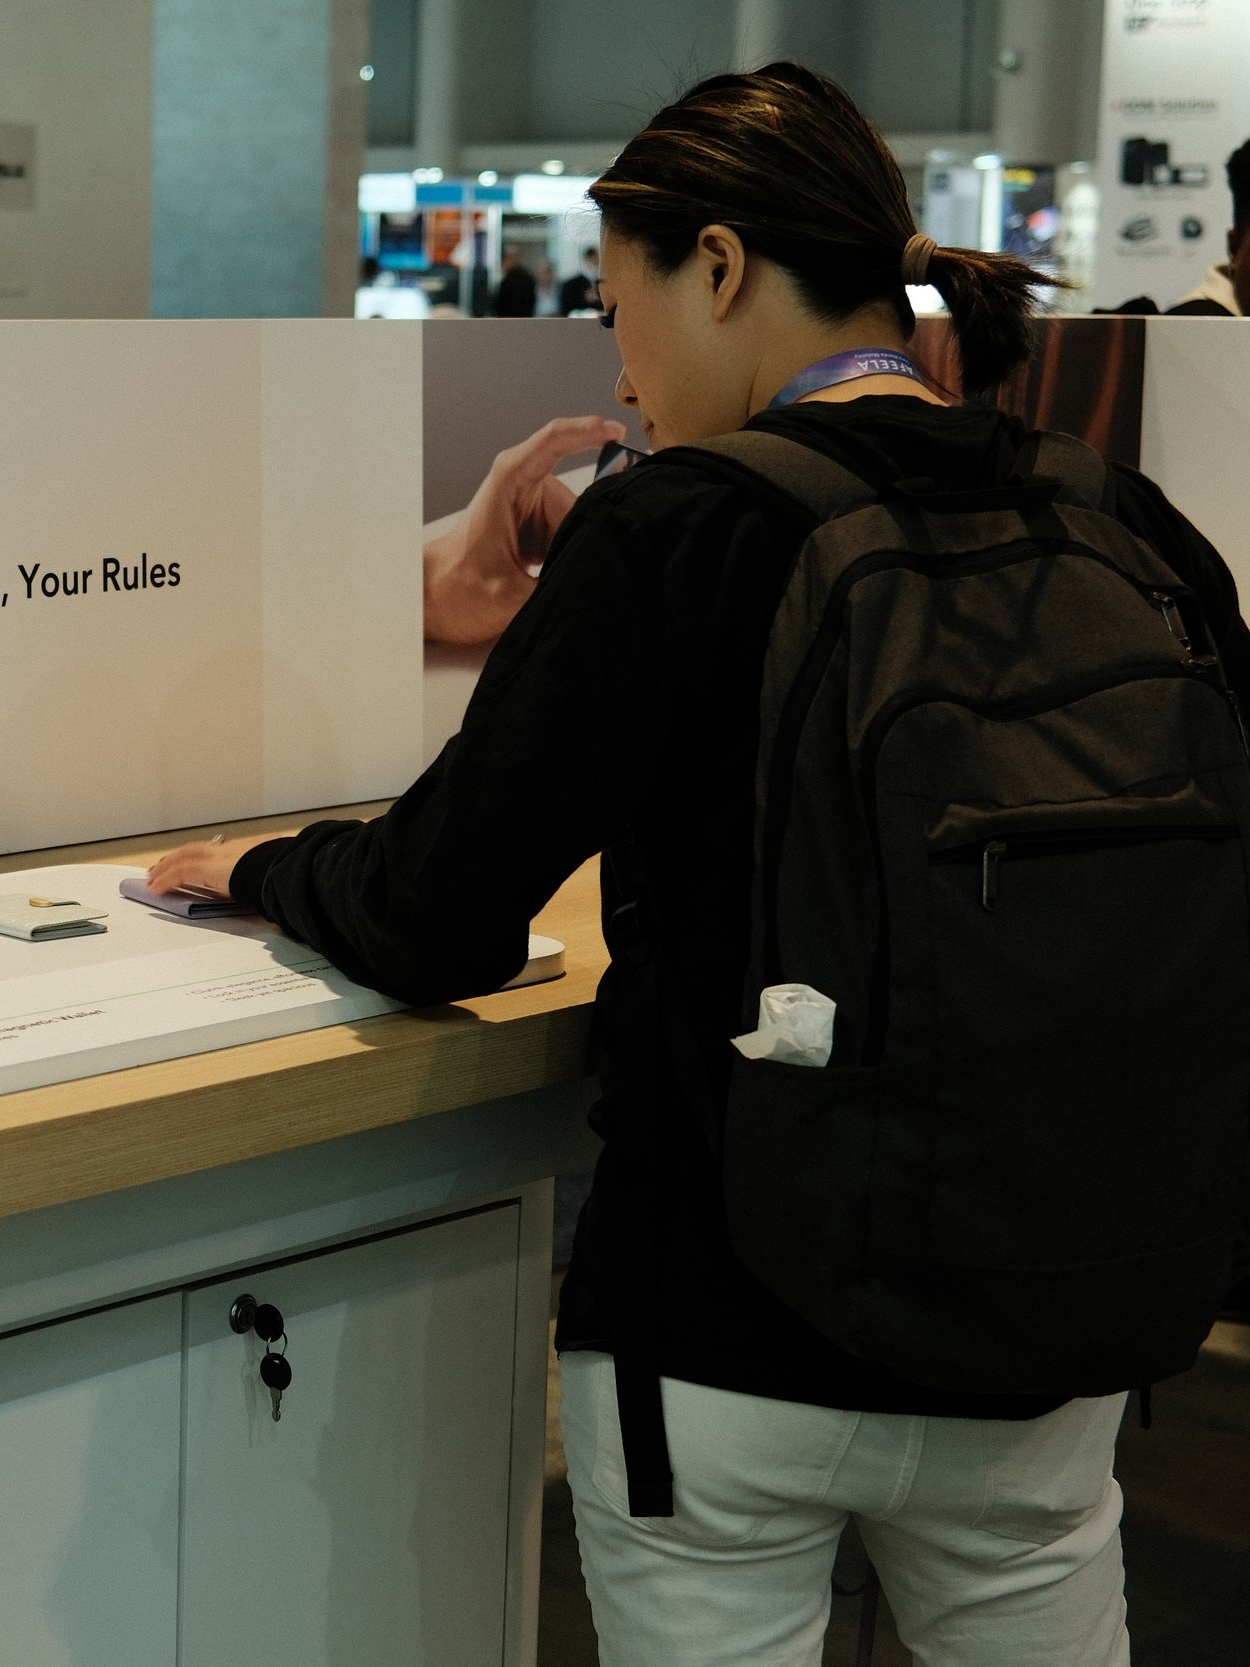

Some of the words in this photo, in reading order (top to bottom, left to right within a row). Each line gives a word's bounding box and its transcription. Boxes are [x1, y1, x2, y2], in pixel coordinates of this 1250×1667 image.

[857, 359, 913, 375] AFEELA
[18, 563, 92, 599] Your
[103, 552, 181, 592] Rules
[54, 1009, 107, 1022] Wallet
